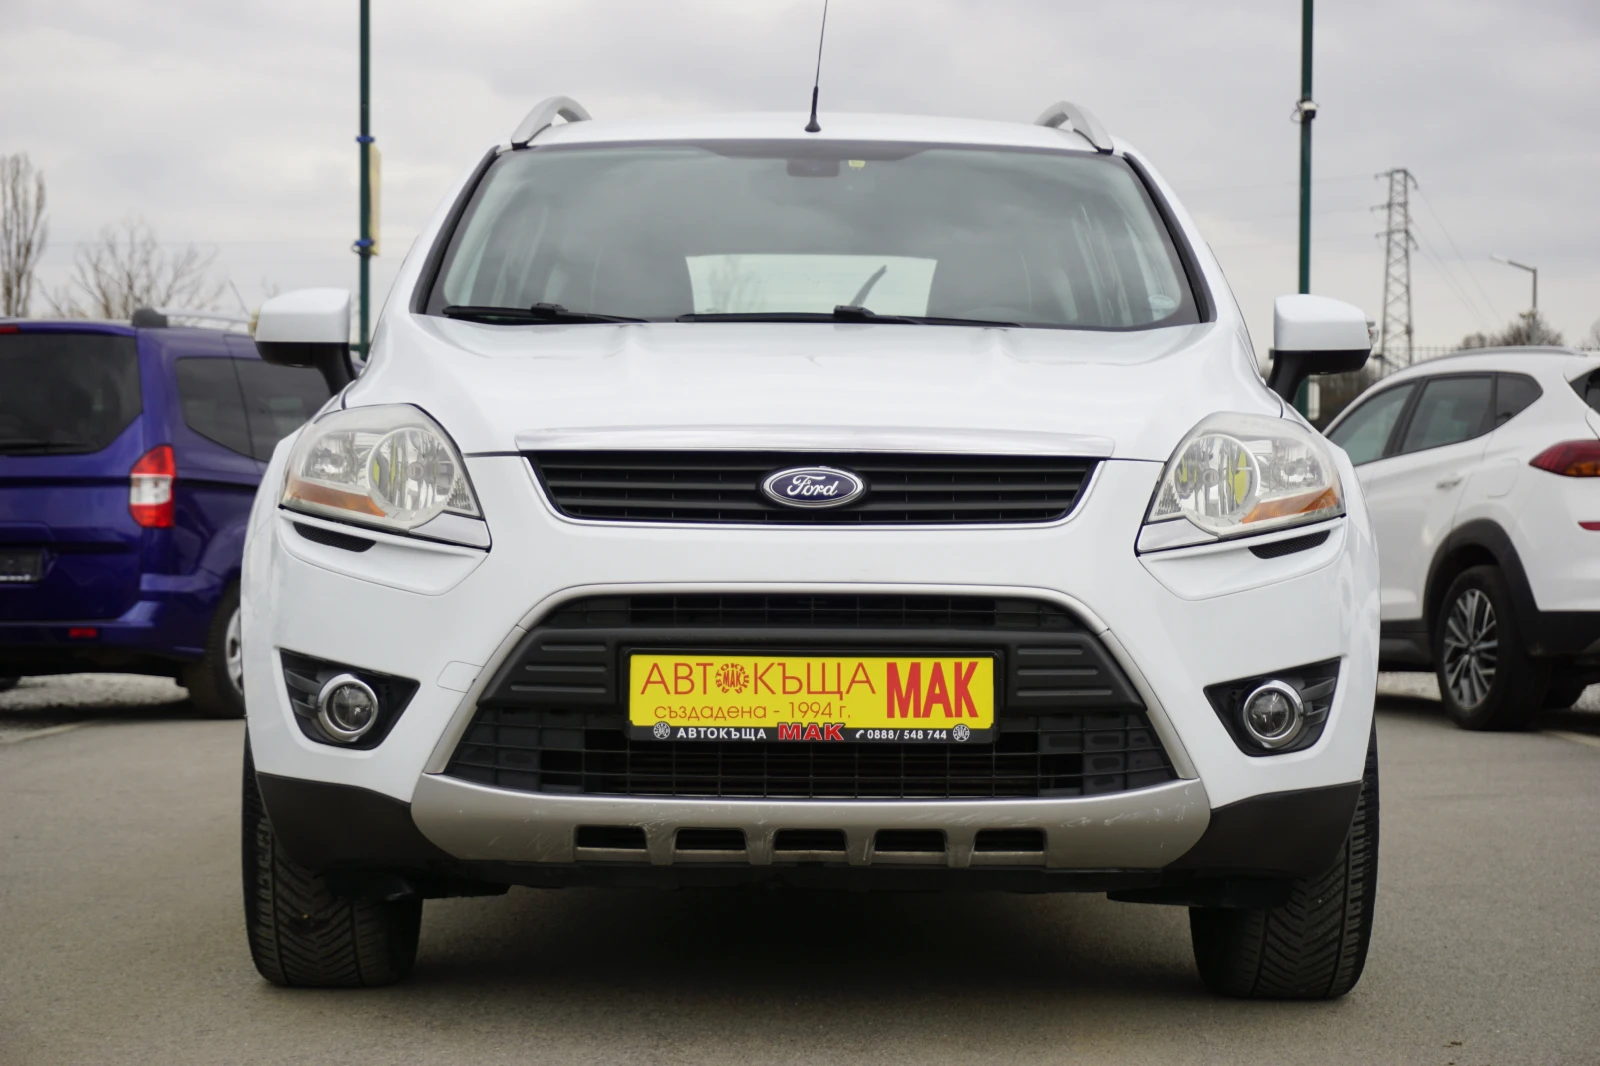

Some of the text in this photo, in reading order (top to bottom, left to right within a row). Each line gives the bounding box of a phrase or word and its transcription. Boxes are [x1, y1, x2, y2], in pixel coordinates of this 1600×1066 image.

[787, 474, 839, 496] Ford
[886, 661, 979, 718] МАК
[654, 705, 767, 721] създадена
[789, 701, 832, 719] 1994
[676, 727, 767, 741] АВТОКЪЩА
[777, 723, 845, 741] МАК
[866, 729, 899, 740] 0888/
[903, 729, 924, 740] 548
[927, 729, 947, 740] 744
